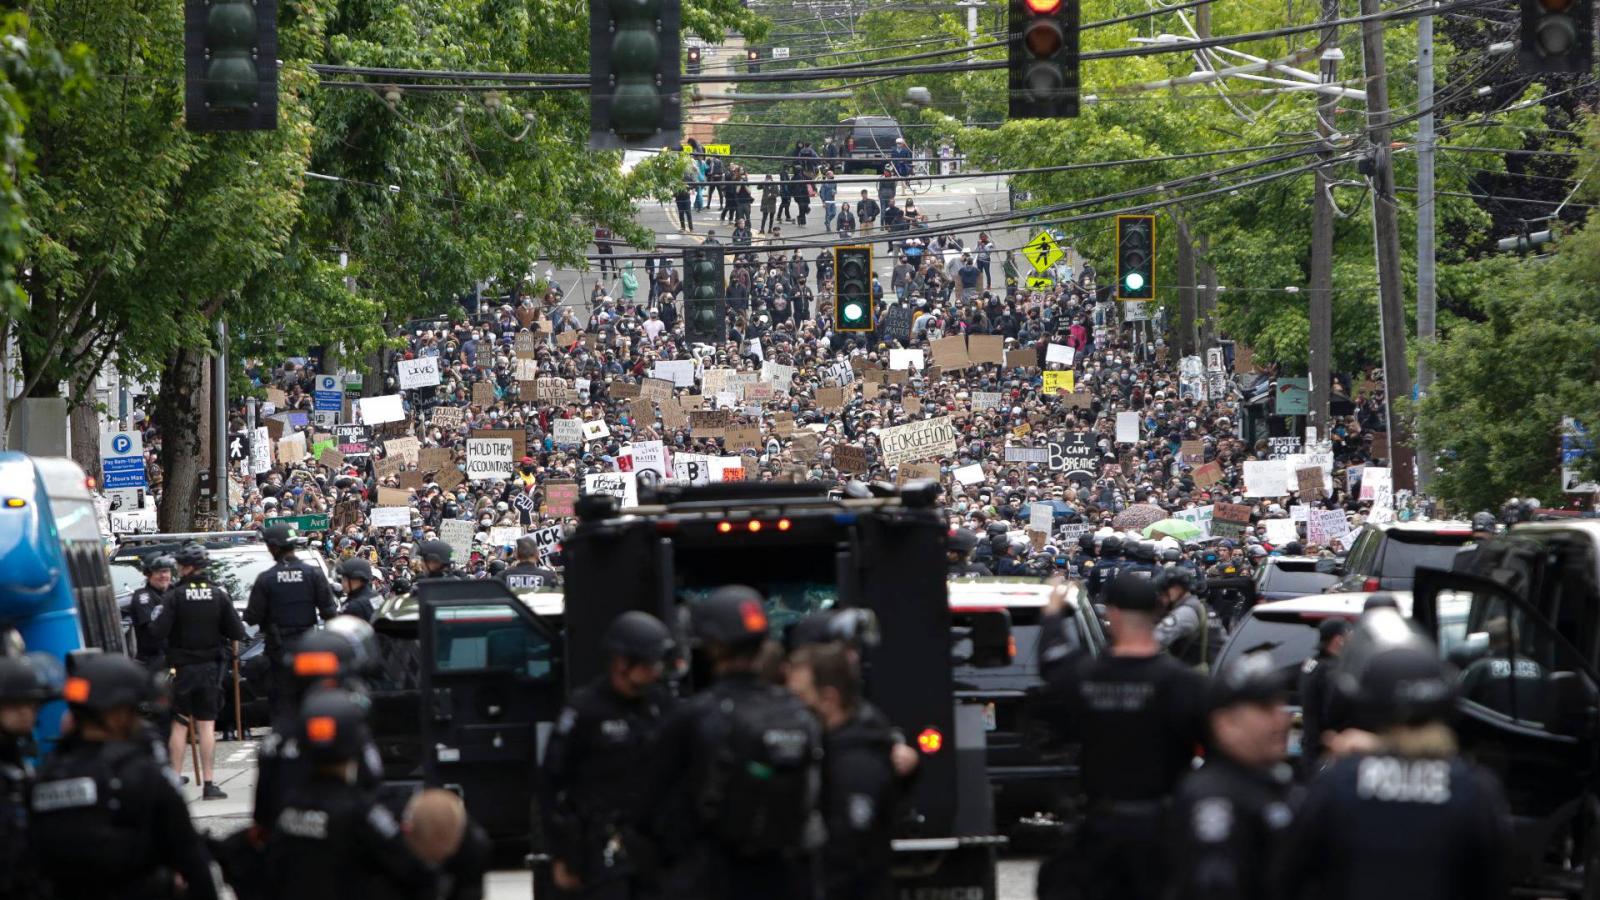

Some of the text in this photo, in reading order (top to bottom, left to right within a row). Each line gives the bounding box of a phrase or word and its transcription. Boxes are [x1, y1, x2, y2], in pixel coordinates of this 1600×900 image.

[408, 365, 435, 375] LIVES
[539, 379, 567, 388] BLACK
[538, 388, 566, 397] LIVES
[337, 427, 365, 436] ENOUGH
[1073, 432, 1085, 443] I
[1268, 437, 1301, 446] JUSTICE
[468, 441, 512, 456] HOLD THEM
[1066, 445, 1091, 455] CAN'T
[1274, 445, 1295, 454] FOR
[467, 460, 514, 472] ACCOUNTABLE
[1062, 457, 1096, 471] BREATHE
[105, 475, 112, 483] 2
[310, 518, 326, 527] Ave
[277, 570, 303, 583] POLICE
[508, 575, 542, 589] POLICE
[185, 587, 213, 600] POLICE
[1490, 660, 1538, 678] POICE
[1356, 756, 1451, 804] POLICE
